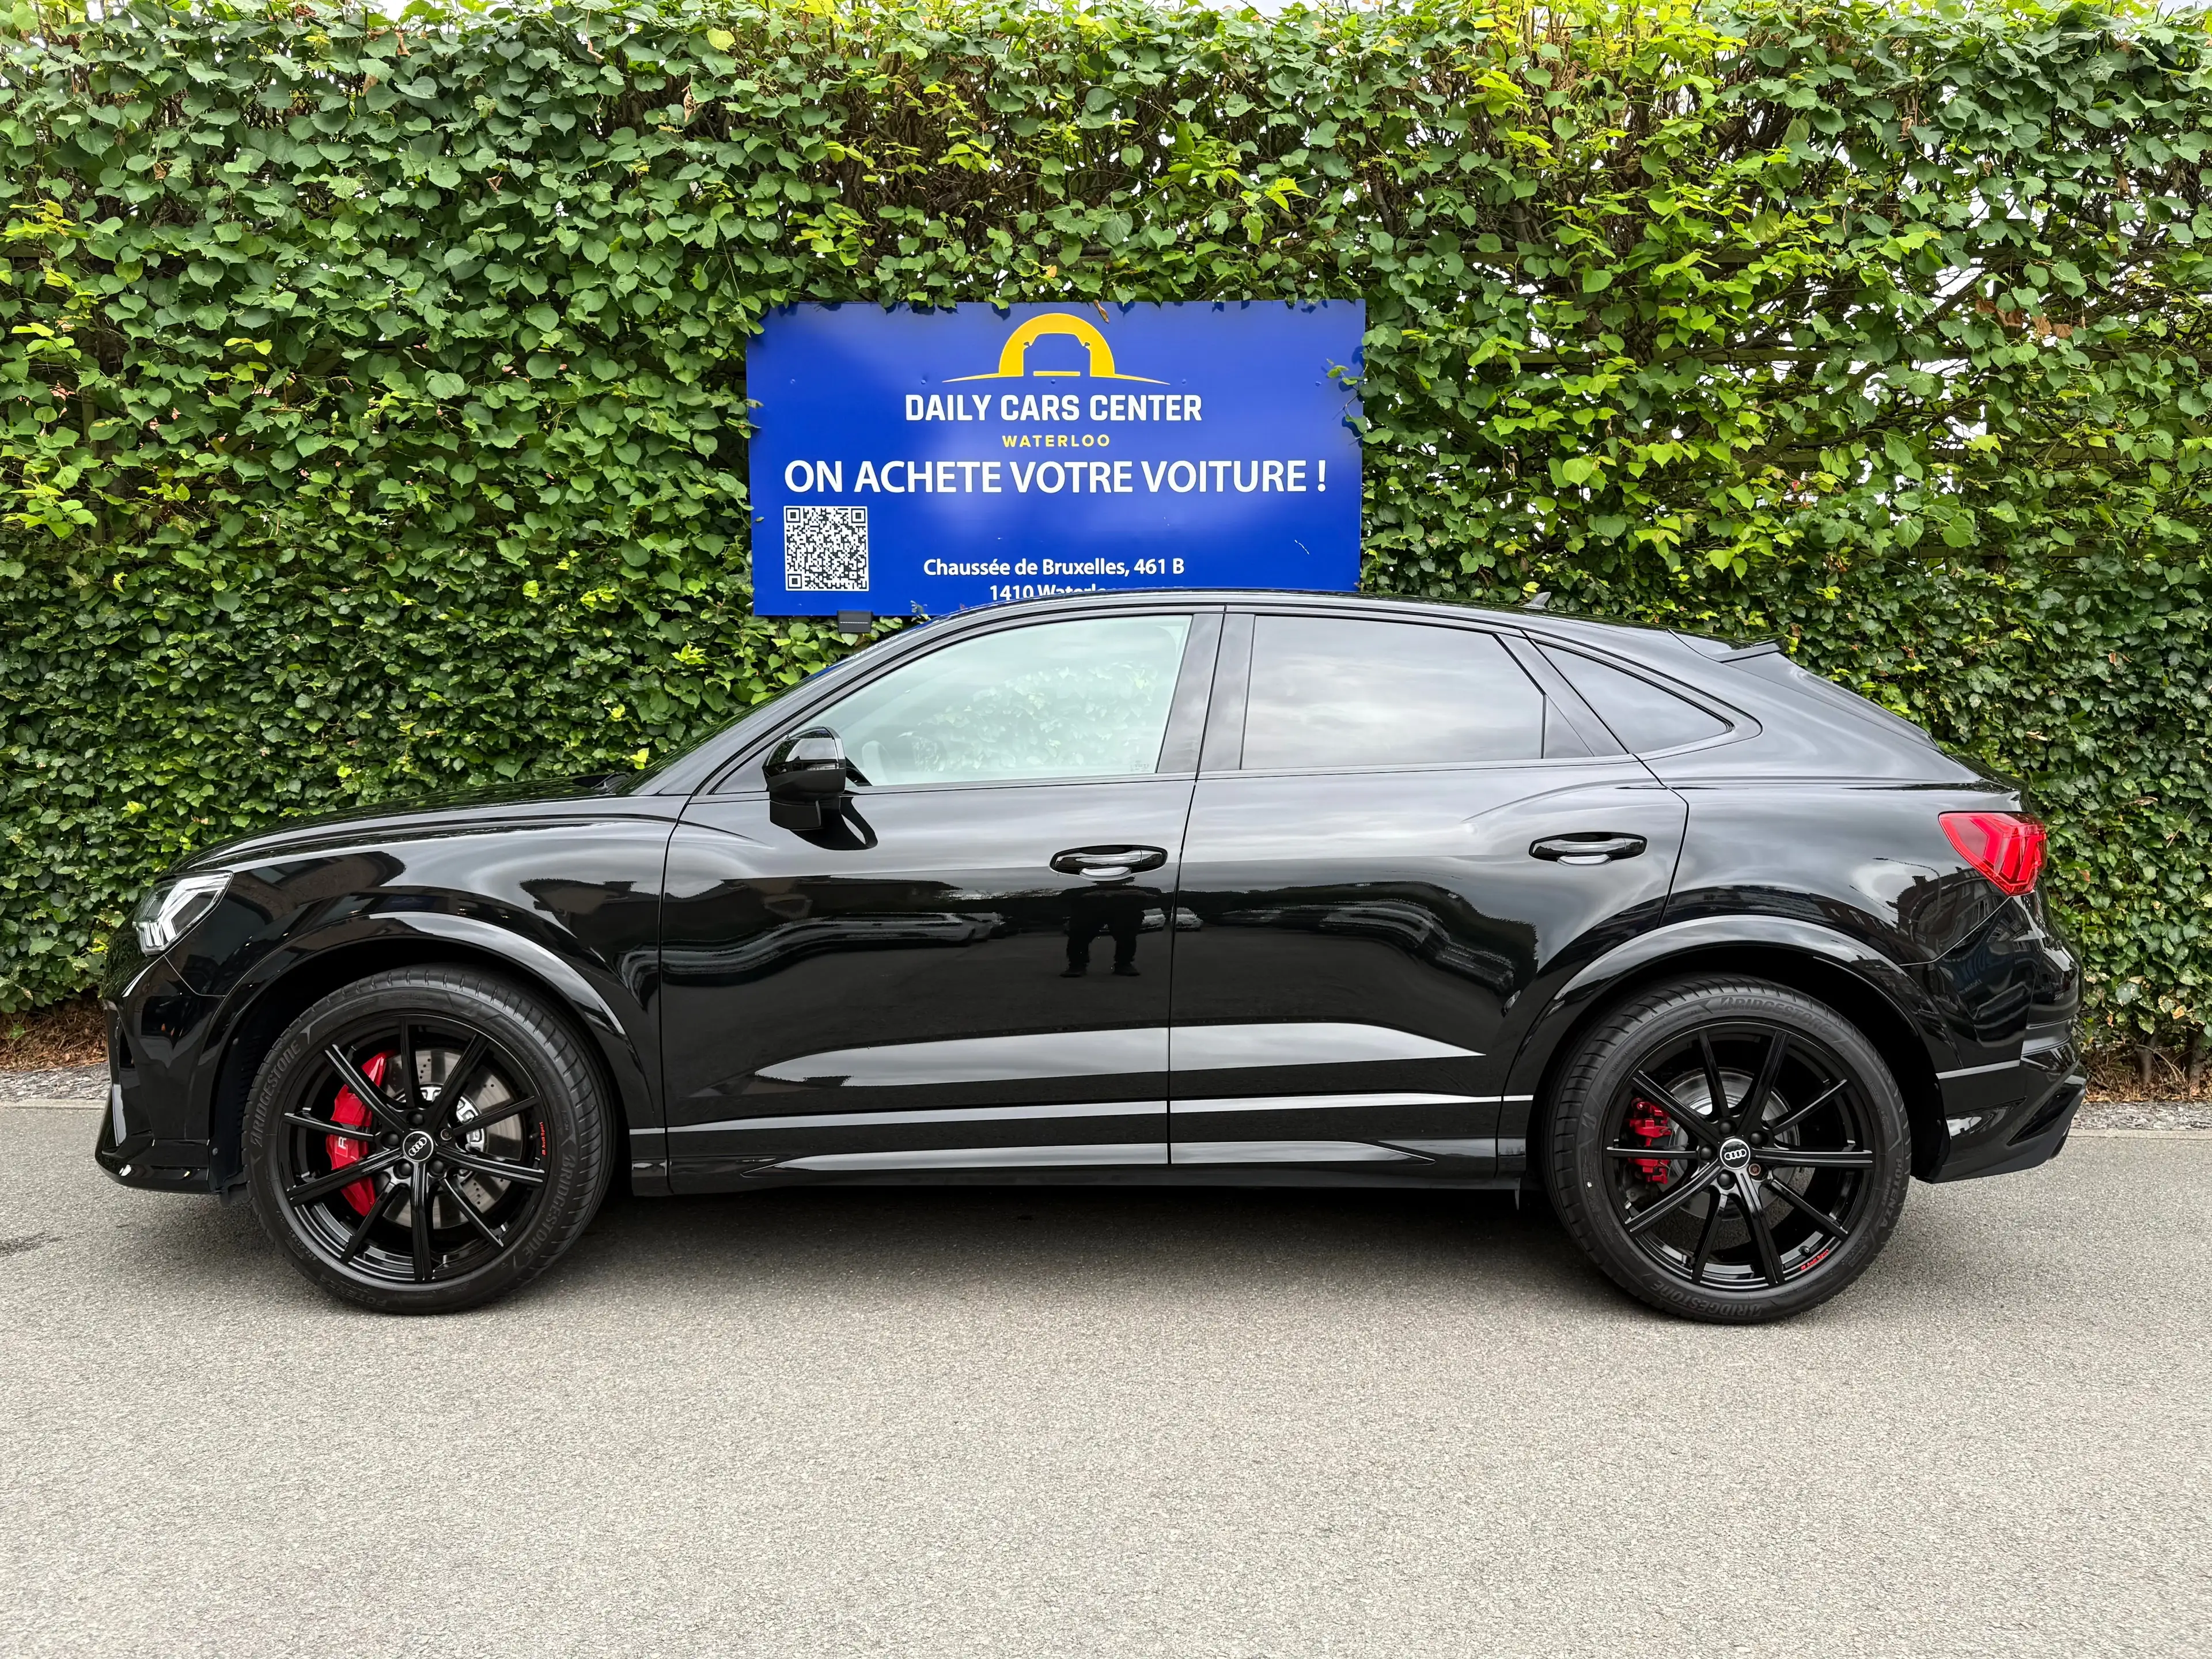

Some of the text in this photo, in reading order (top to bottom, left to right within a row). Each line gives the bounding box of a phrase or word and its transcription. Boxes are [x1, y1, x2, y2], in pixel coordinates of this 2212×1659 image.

[905, 394, 1202, 421] DAILY CARS CENTER
[1002, 435, 1110, 447] WATERLOO
[784, 460, 843, 493] ON
[854, 460, 1002, 493] ACHETE
[1009, 461, 1133, 494] VOTRE
[1141, 460, 1306, 493] VOITURE
[923, 558, 1184, 577] Chaussée de Bruxelles, 461 B
[990, 585, 1035, 601] 1410
[1720, 997, 1832, 1035] BRIDGESTONE
[249, 1039, 302, 1148] BRIDGESTONE
[522, 1153, 577, 1259] BRIDGESTONE
[1650, 1280, 1763, 1317] BRIDGESTONE
